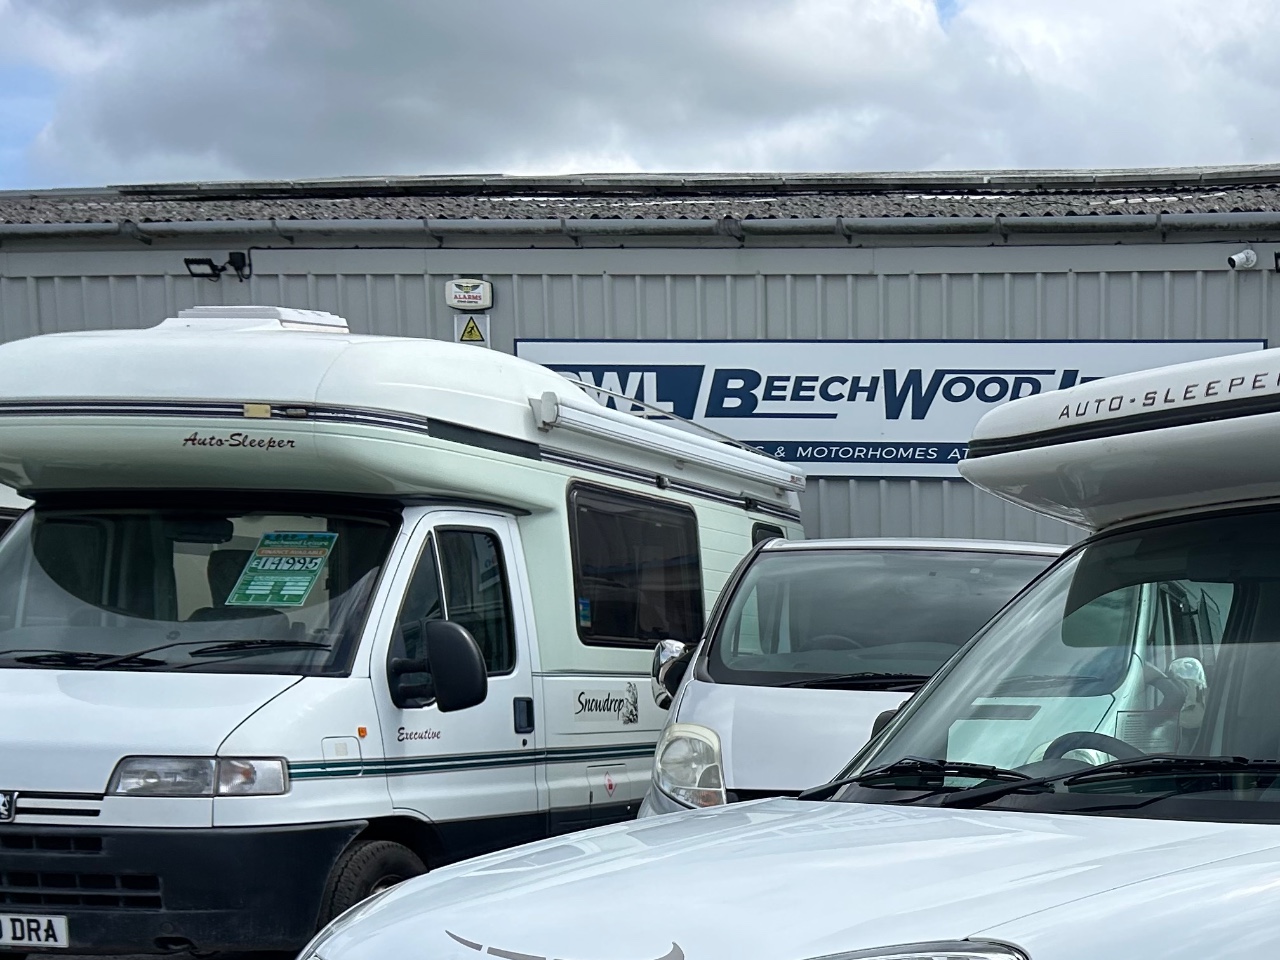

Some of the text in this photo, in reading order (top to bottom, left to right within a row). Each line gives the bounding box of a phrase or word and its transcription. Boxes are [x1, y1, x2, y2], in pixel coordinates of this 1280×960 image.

[556, 371, 674, 413] WL
[182, 431, 296, 451] Auto-Sleeper
[796, 446, 938, 460] MOTORHOMES
[574, 691, 625, 721] Snowdrop
[397, 727, 441, 742] Executive
[10, 918, 58, 942] DRA
